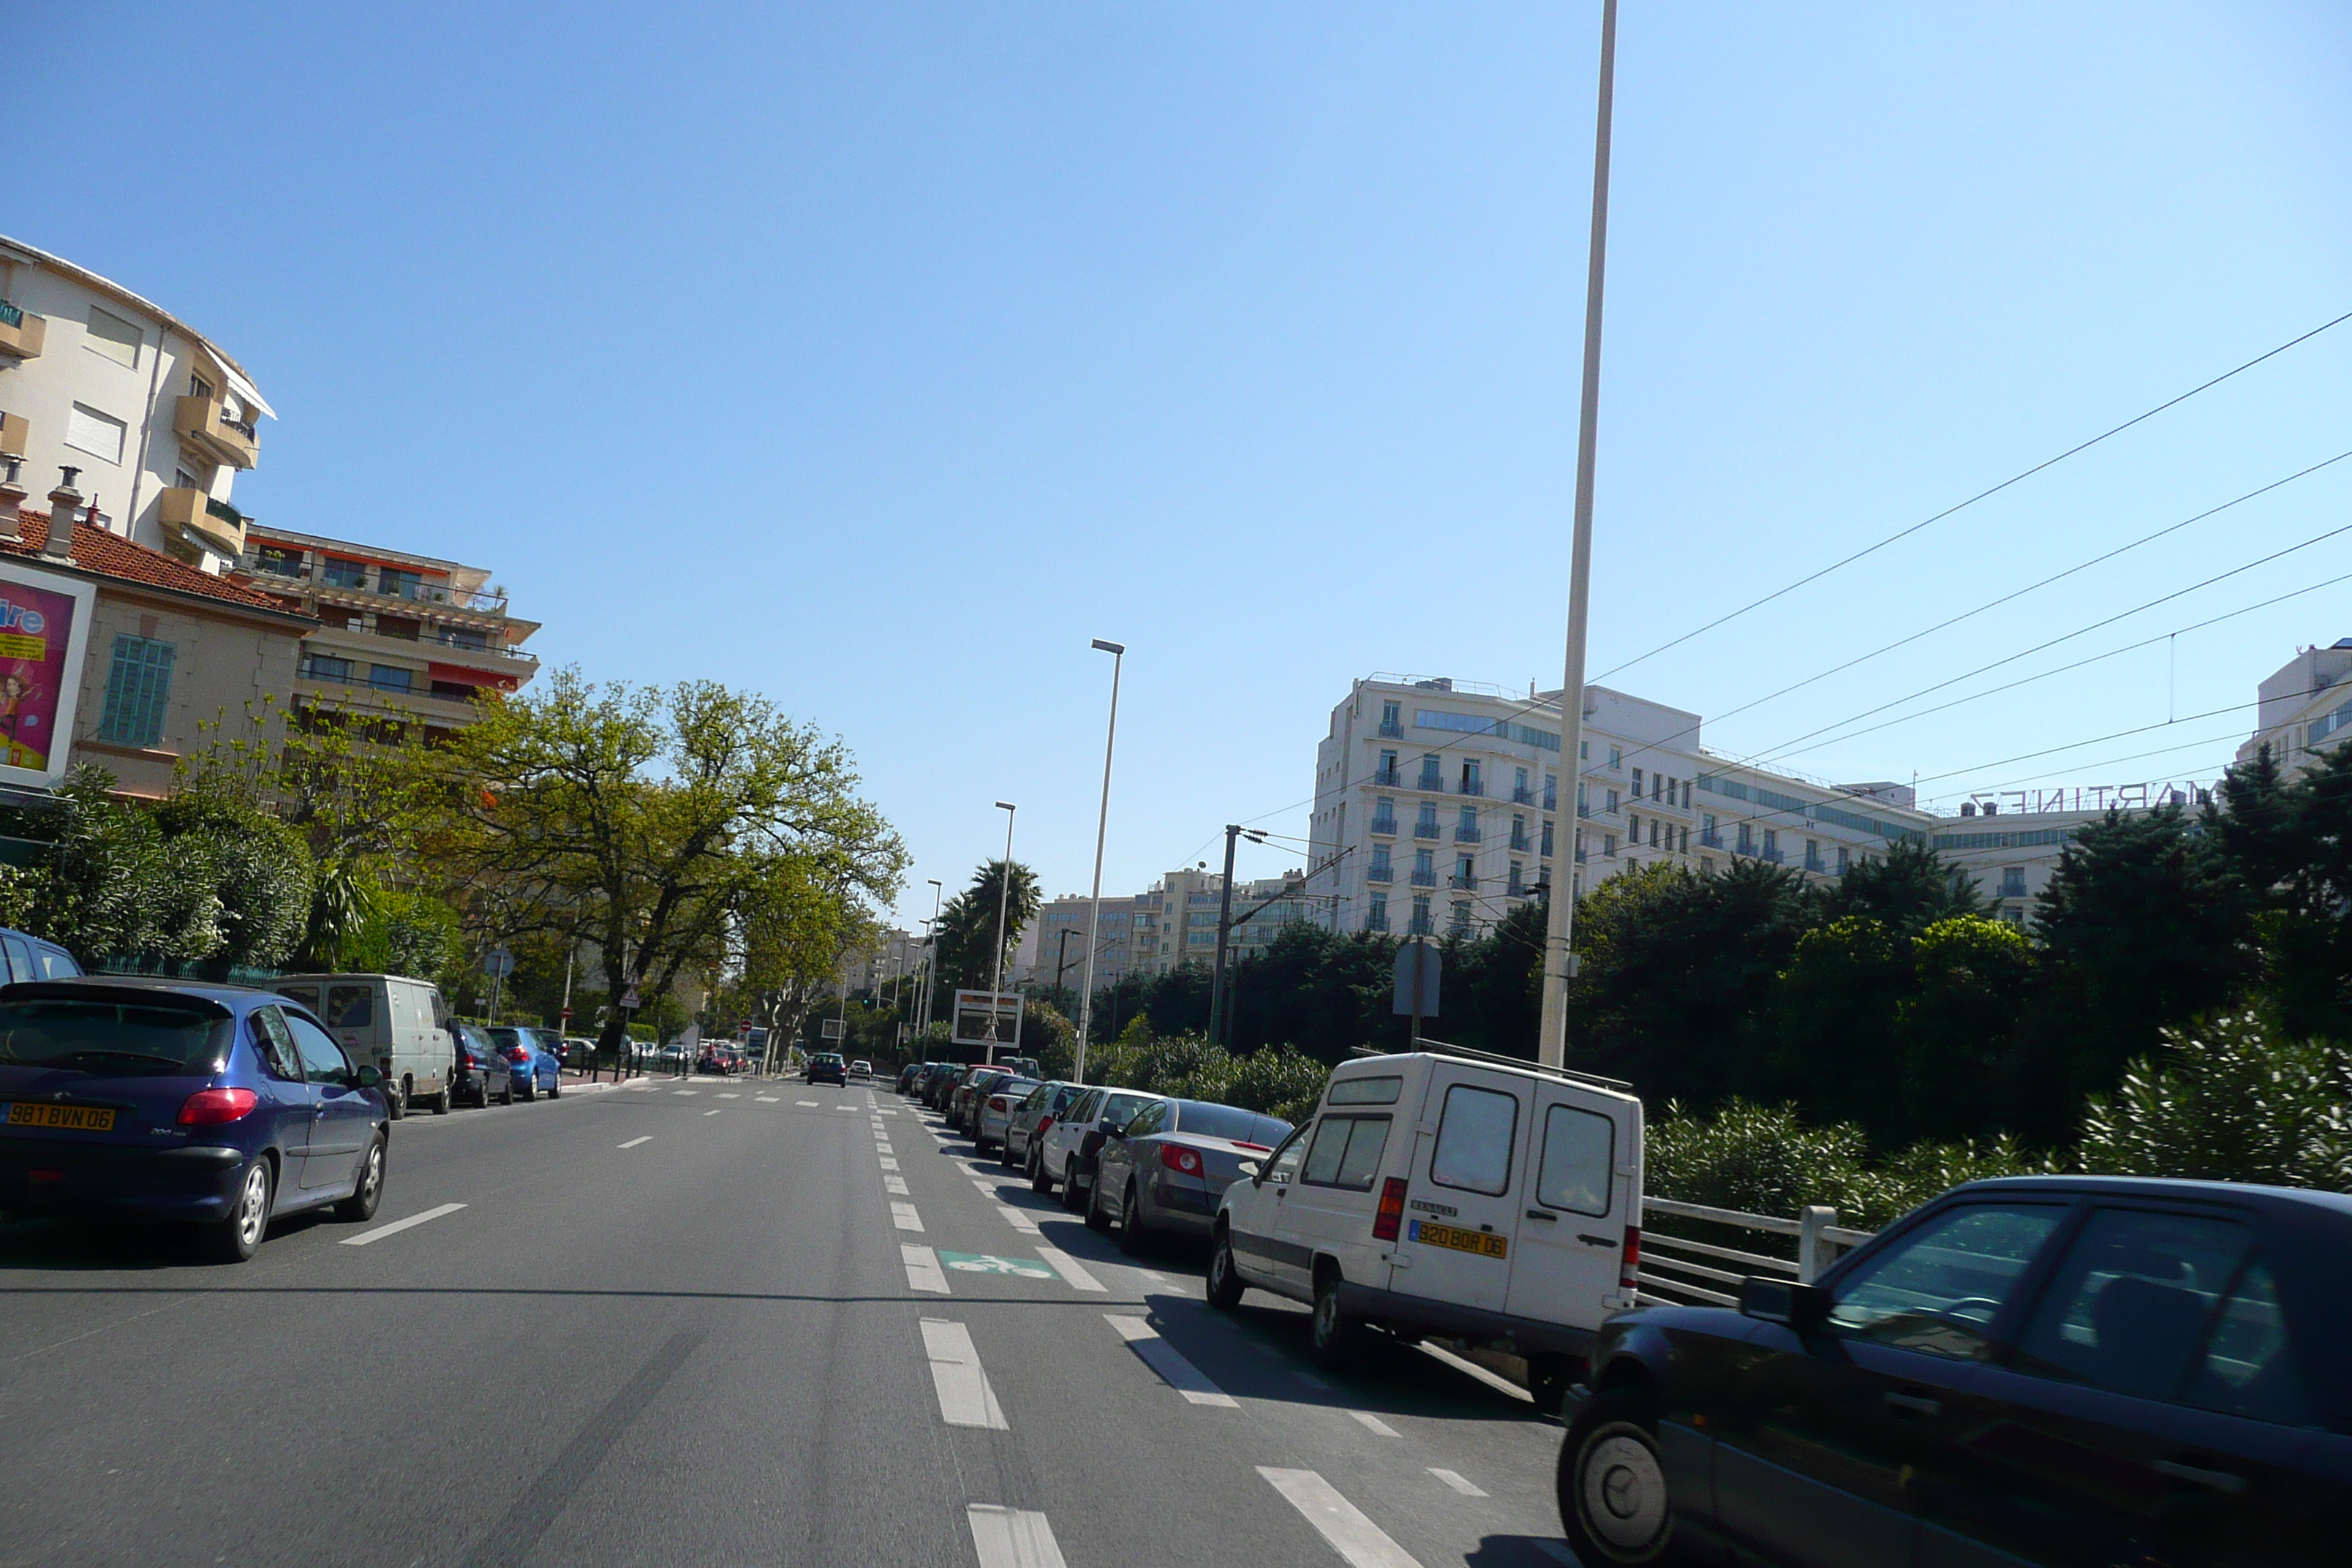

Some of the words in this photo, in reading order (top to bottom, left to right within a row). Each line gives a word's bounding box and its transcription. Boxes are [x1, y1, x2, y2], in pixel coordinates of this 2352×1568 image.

[10, 1105, 45, 1123] 981
[48, 1107, 84, 1126] BVN
[87, 1110, 111, 1128] 06
[1419, 1224, 1449, 1245] 920
